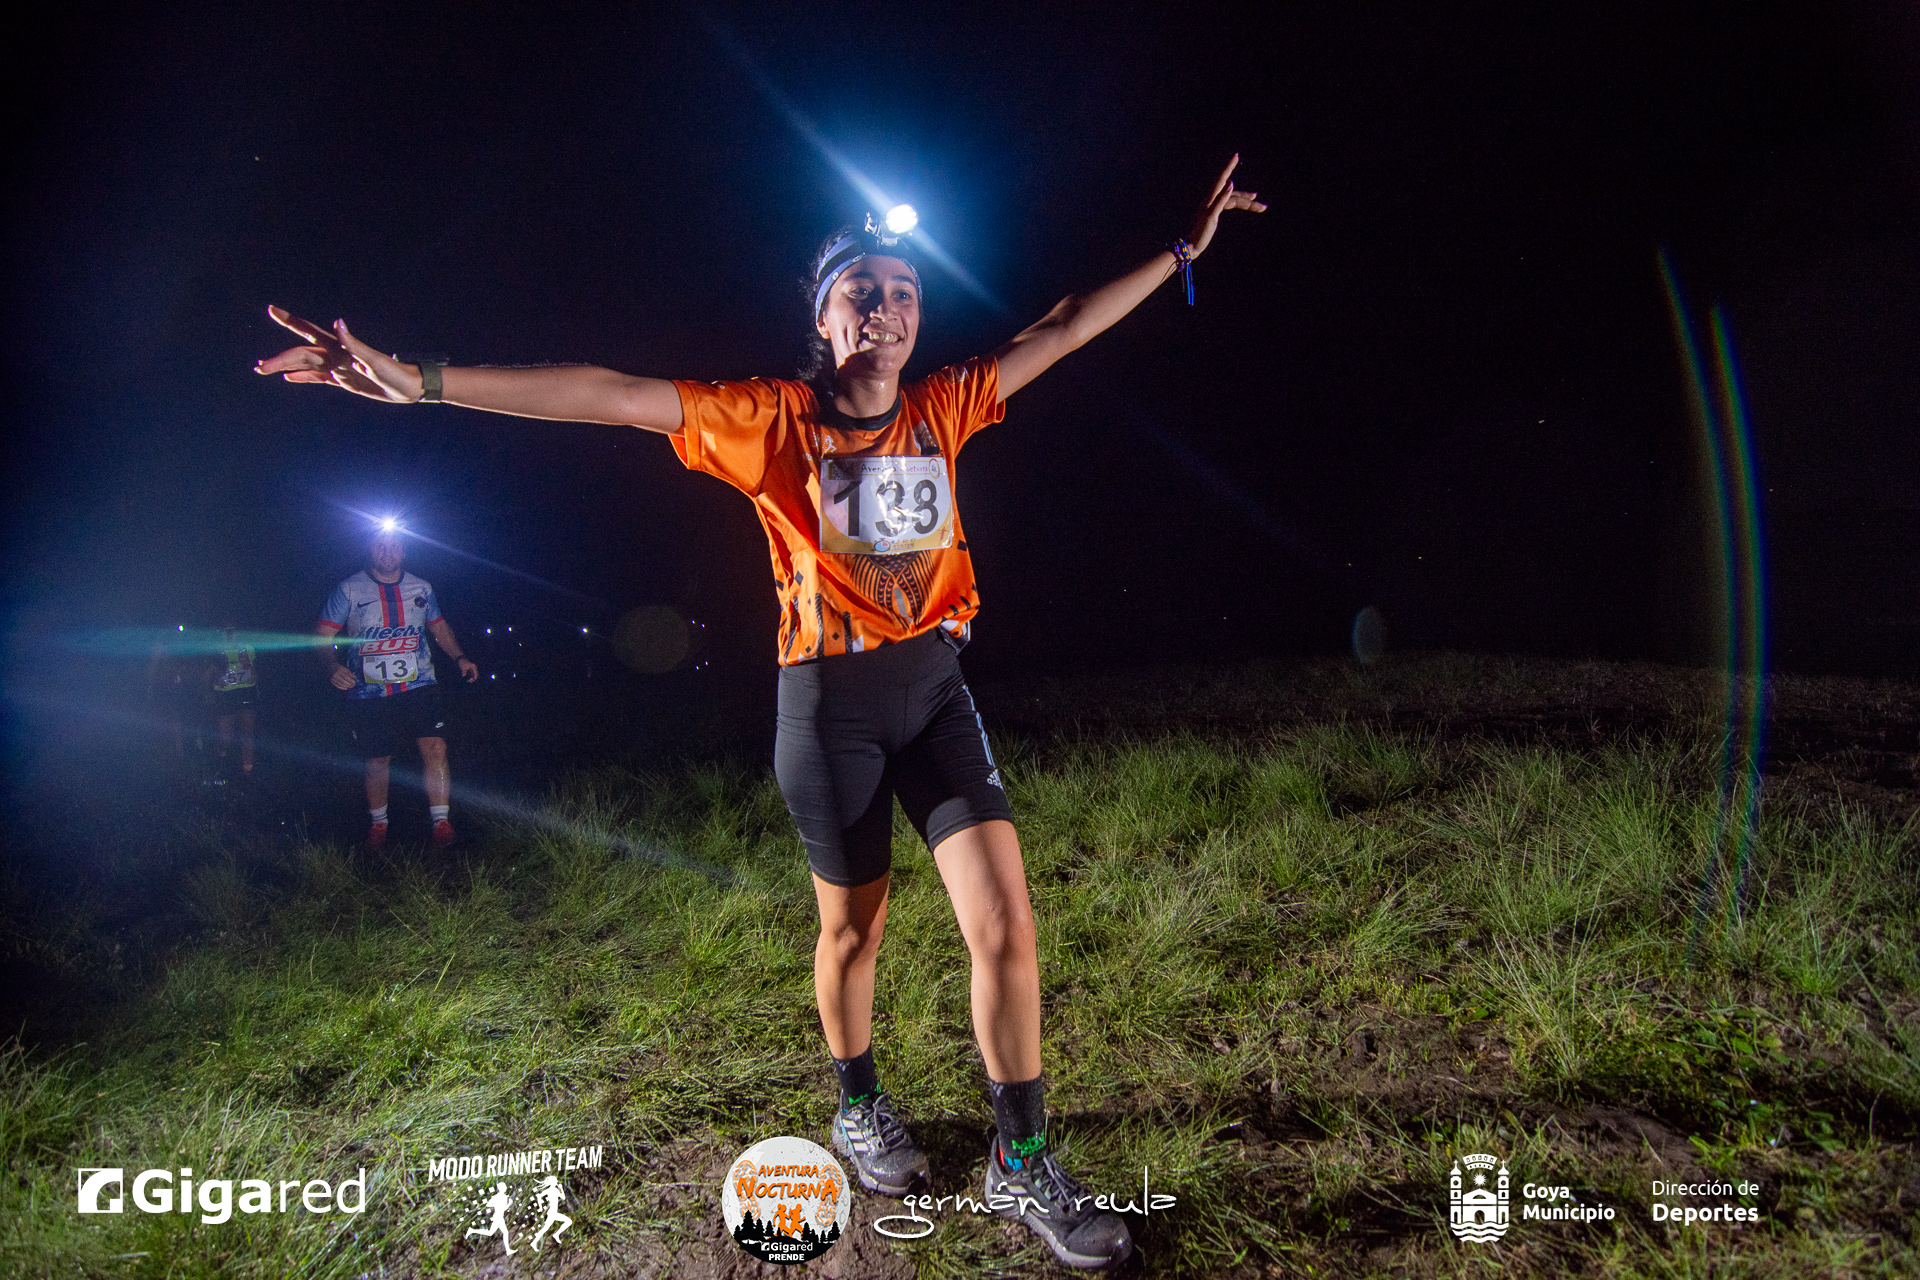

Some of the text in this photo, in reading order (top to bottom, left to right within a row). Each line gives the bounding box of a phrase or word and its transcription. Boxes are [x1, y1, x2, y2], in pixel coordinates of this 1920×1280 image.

[834, 479, 939, 537] 138
[362, 637, 418, 653] BUS
[375, 660, 408, 679] 13
